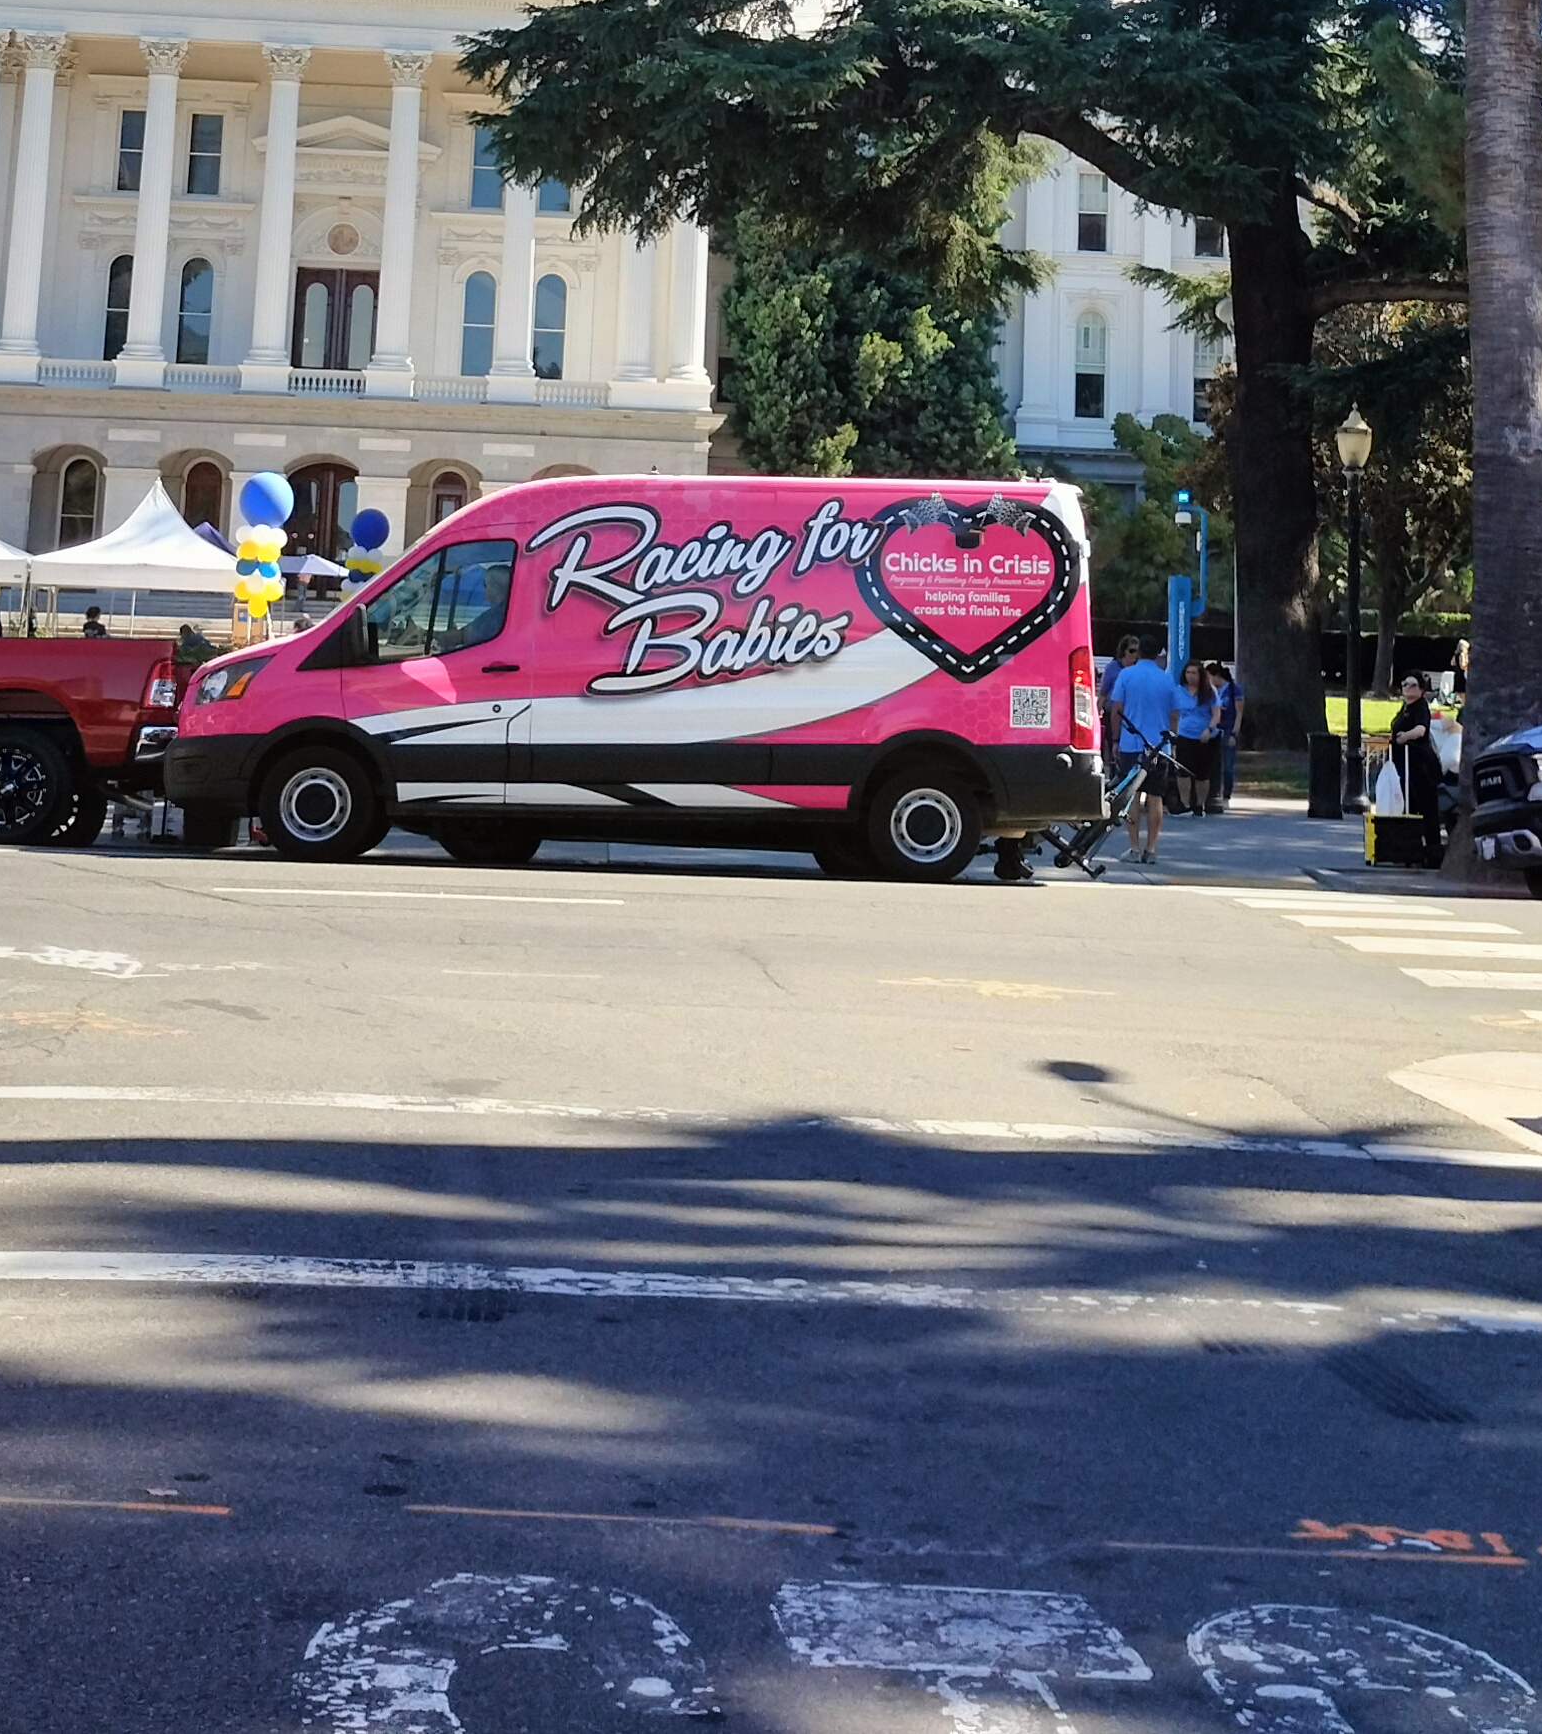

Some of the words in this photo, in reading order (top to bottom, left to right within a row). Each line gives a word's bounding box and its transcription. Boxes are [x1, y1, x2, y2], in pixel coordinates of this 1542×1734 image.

[525, 501, 796, 613] Racing
[792, 497, 886, 577] for
[884, 551, 957, 573] Chicks
[963, 552, 983, 574] in
[988, 553, 1051, 575] Crisis
[924, 590, 966, 604] helping
[968, 591, 1011, 604] families
[913, 606, 946, 616] cross
[947, 605, 967, 616] the
[969, 604, 1000, 617] finish
[1002, 605, 1023, 617] line
[585, 587, 854, 697] Babies
[1479, 775, 1502, 788] RAM
